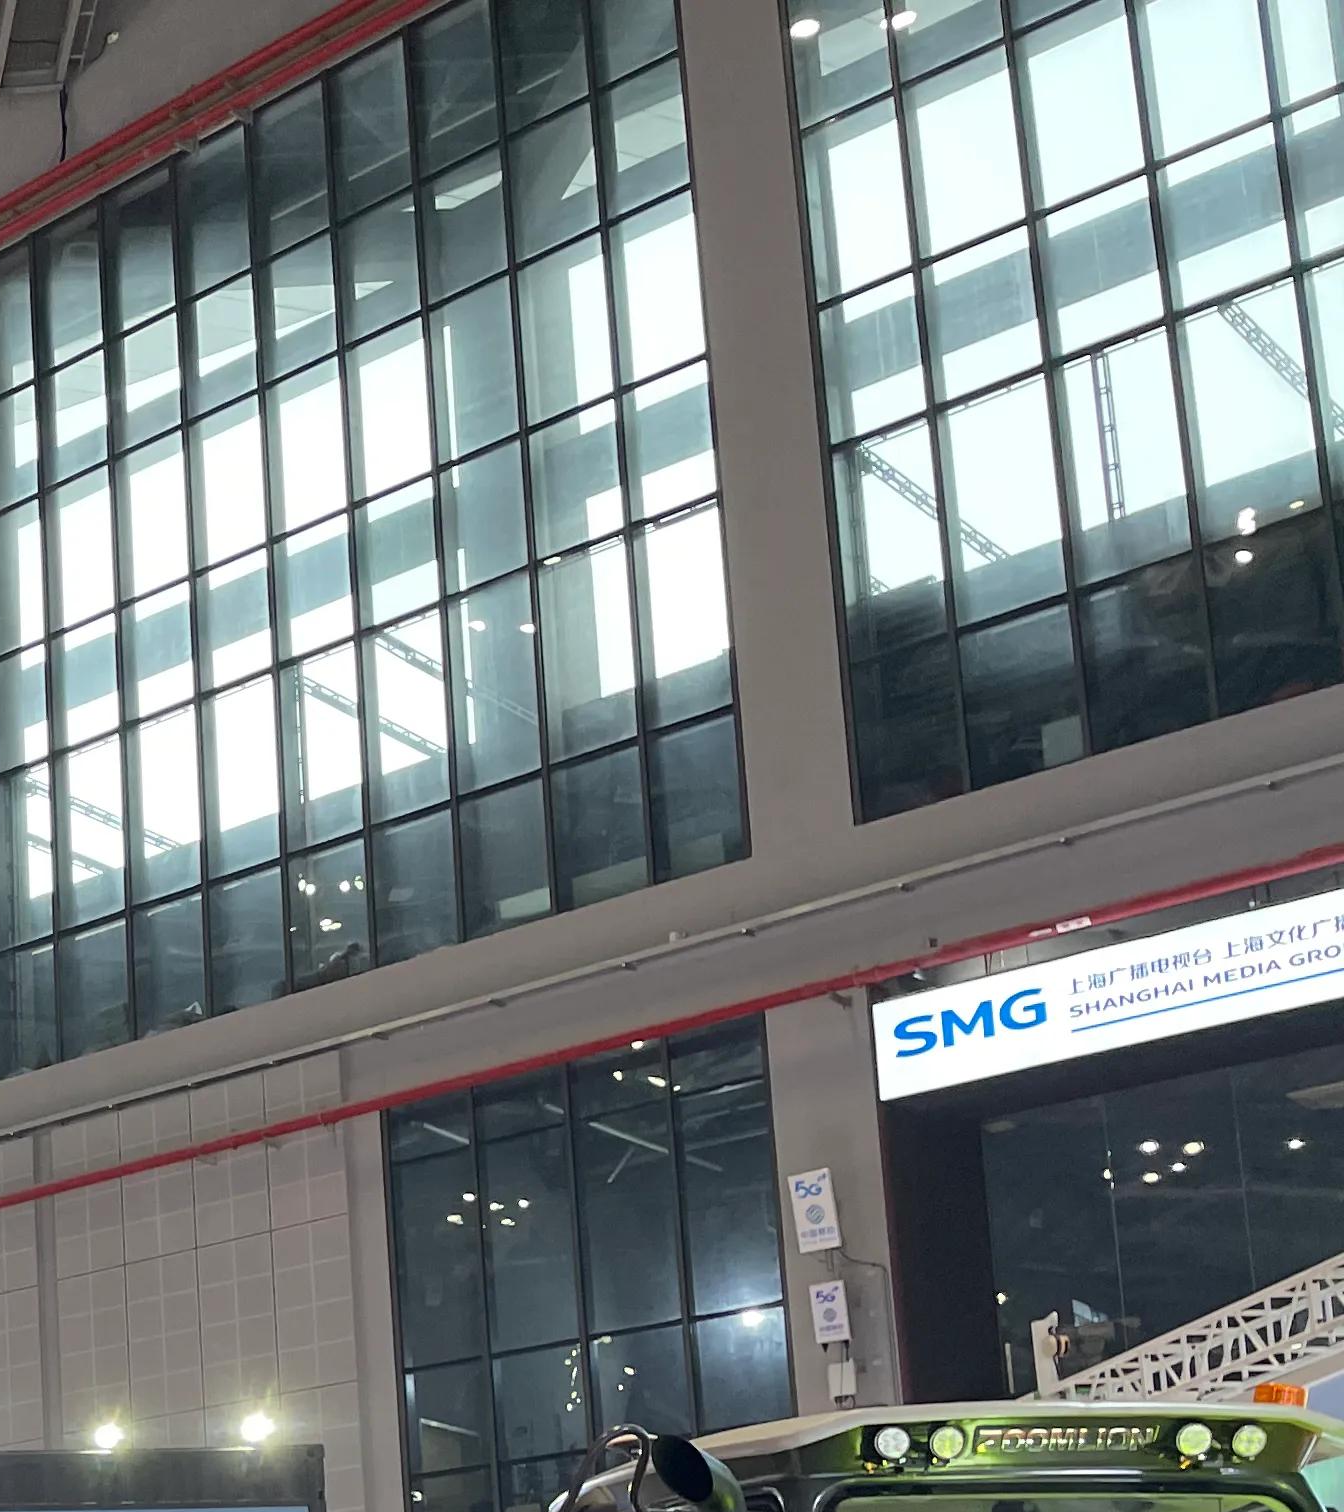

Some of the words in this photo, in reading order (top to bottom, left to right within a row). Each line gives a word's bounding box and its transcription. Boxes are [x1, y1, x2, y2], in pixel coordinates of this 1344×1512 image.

[1069, 948, 1212, 997] 上海广播电视台
[1069, 979, 1194, 1018] SHANGHAI
[1203, 959, 1282, 988] MEDIA
[894, 988, 1047, 1058] SMG
[977, 1426, 1160, 1452] ZOOMLION
